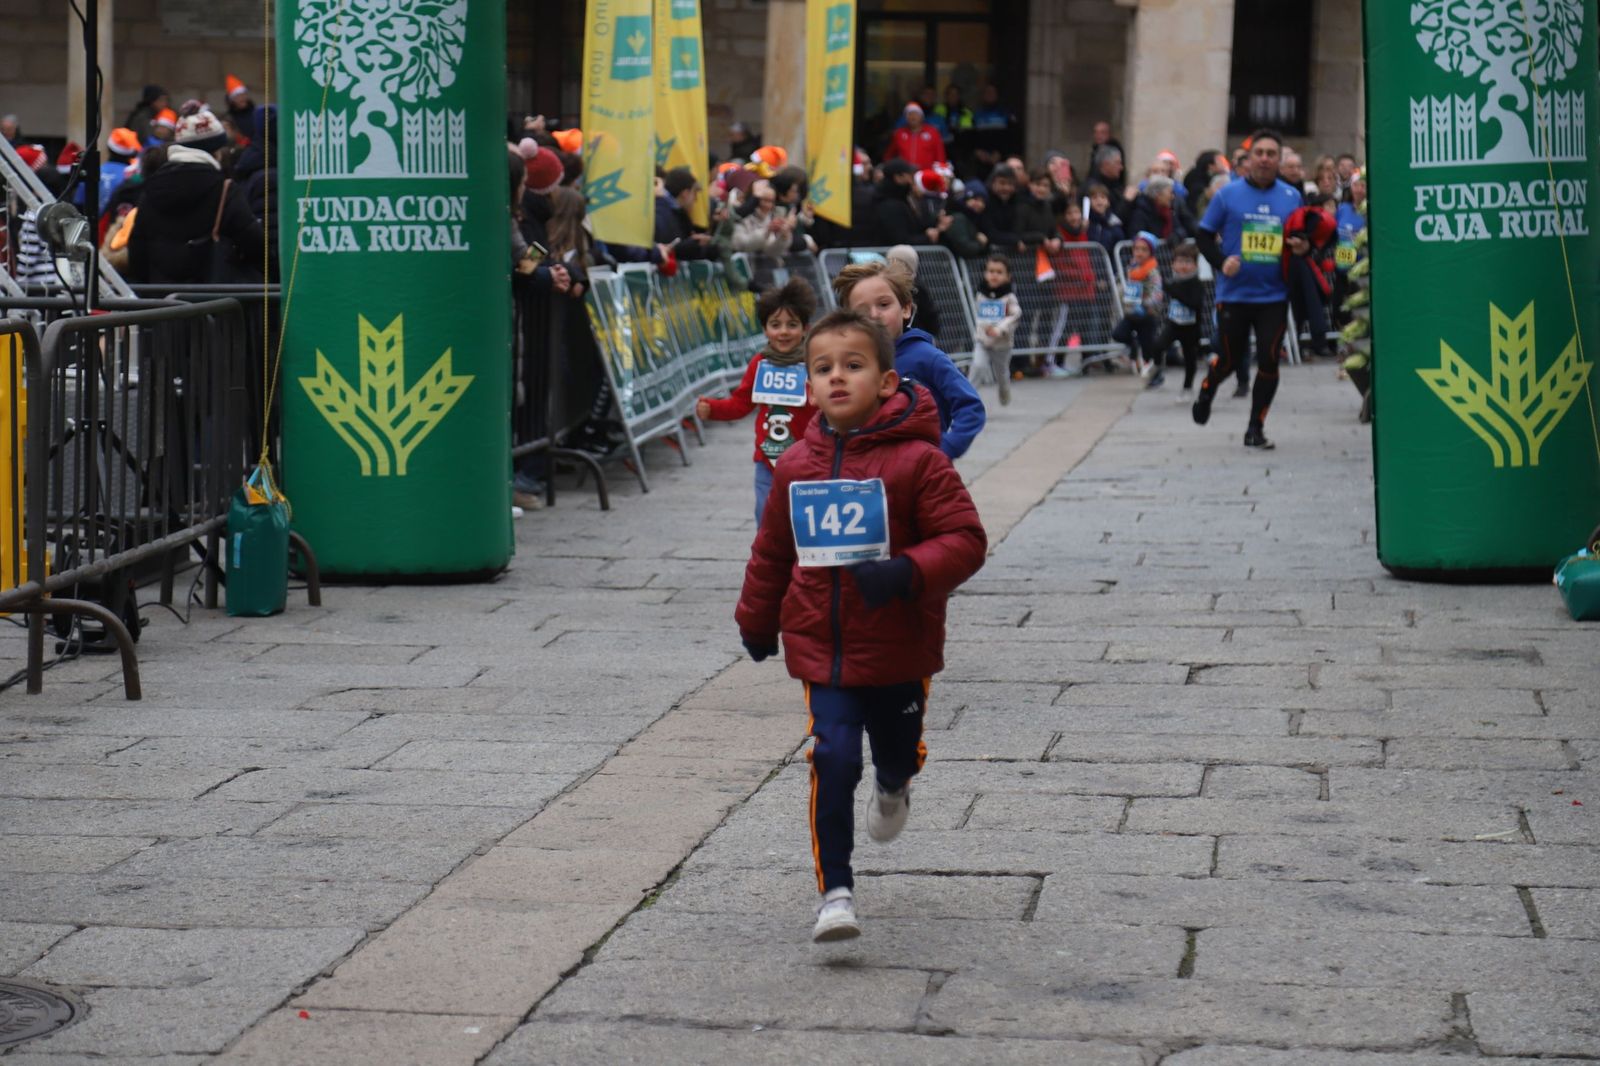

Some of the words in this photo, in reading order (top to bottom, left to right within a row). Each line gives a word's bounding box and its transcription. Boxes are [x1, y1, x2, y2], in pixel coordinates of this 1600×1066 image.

[297, 196, 468, 222] FUNDACION
[1414, 180, 1587, 211] FUNDACION
[299, 226, 360, 253] CAJA
[368, 225, 469, 251] RURAL
[1415, 212, 1491, 243] CAJA
[1499, 209, 1589, 239] RURAL
[1248, 235, 1275, 251] 1147
[762, 371, 797, 390] 055
[804, 502, 866, 537] 142
